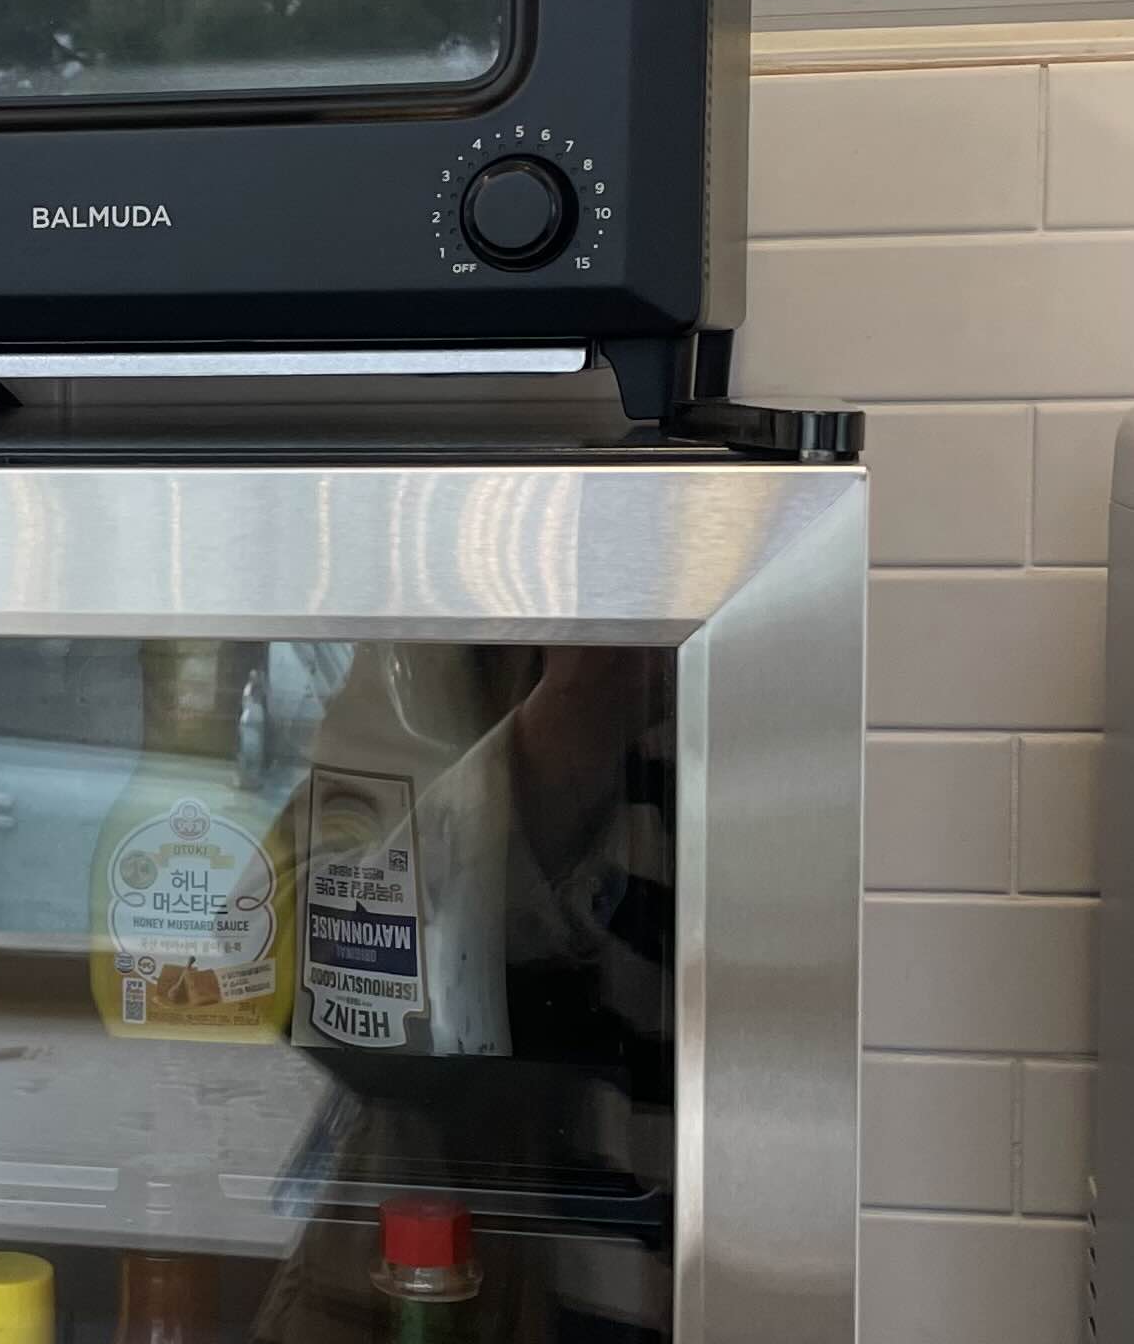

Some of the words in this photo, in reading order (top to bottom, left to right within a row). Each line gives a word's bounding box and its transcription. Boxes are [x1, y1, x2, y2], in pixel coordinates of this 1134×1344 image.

[515, 125, 524, 138] 5
[541, 129, 551, 141] 6
[472, 138, 482, 150] 4
[565, 140, 574, 152] 7
[583, 159, 593, 171] 8
[442, 170, 450, 182] 3
[595, 182, 605, 194] 9
[31, 205, 172, 229] BALMUDA
[432, 211, 441, 223] 2
[594, 207, 611, 219] 10
[439, 247, 445, 258] 1
[452, 263, 477, 274] OFF
[575, 257, 591, 269] 15
[170, 869, 209, 892] 허니
[153, 892, 228, 916] 머스타드
[133, 918, 164, 929] HONEY
[167, 919, 213, 931] MUSTARD
[216, 920, 250, 932] SAUCE
[311, 914, 411, 950] MAYONNAISE
[323, 998, 390, 1038] HEINZ
